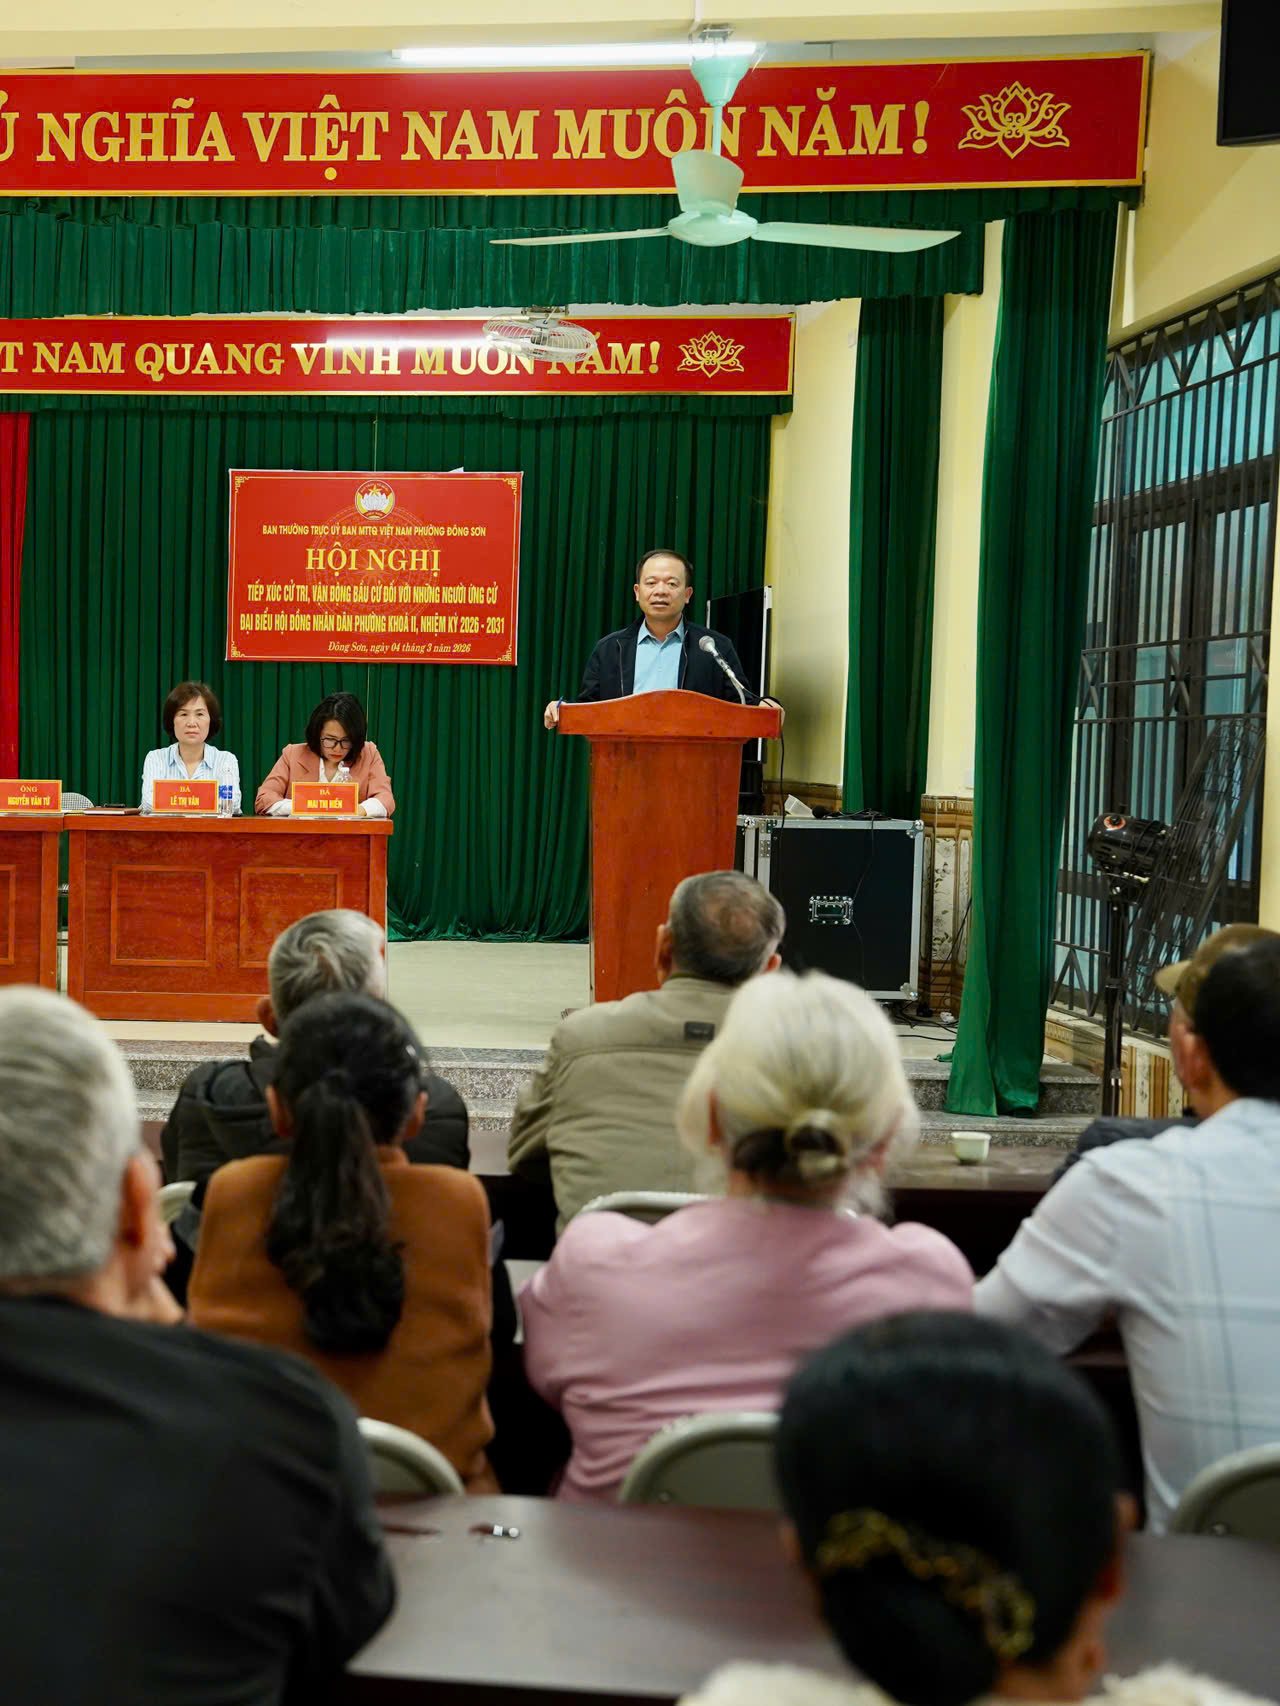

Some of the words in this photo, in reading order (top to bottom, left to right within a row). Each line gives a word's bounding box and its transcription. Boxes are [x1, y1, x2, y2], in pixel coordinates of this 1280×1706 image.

[35, 97, 235, 163] NGHĨA
[243, 94, 389, 181] VIỆT
[400, 109, 540, 160] NAM
[552, 89, 741, 160] MUÔN
[32, 341, 125, 374] NAM
[134, 341, 285, 382] QUANG
[291, 342, 401, 375] VINH
[262, 525, 278, 534] BAN
[279, 522, 309, 534] THƯỜNG
[311, 525, 329, 537] TRỰC
[342, 526, 356, 536] BAN
[358, 526, 378, 536] MTTQ
[380, 524, 394, 538] VIỆT
[396, 526, 412, 536] NAM
[414, 524, 444, 536] PHƯỜNG
[446, 524, 469, 536] ĐÔNG
[470, 525, 486, 536] SƠN
[305, 542, 359, 576] HỘI
[366, 548, 441, 578] NGHỊ
[248, 579, 264, 602] TIẾP
[266, 581, 282, 602] XÚC
[284, 579, 296, 602] CỬ
[296, 585, 310, 604] TRI,
[312, 582, 328, 606] VẬN
[330, 582, 351, 606] ĐỘNG
[353, 580, 368, 602] BẦU
[371, 580, 383, 603] CỬ
[384, 580, 396, 603] ĐỐI
[398, 582, 411, 603] VỚI
[413, 583, 440, 604] NHỮNG
[442, 582, 466, 604] NGƯỜI
[468, 582, 484, 604] ỨNG
[486, 581, 498, 604] CỬ
[240, 613, 254, 635] ĐẠI
[255, 606, 272, 631] BIỂU
[275, 610, 288, 635] HỘI
[290, 608, 311, 632] ĐỒNG
[312, 611, 334, 632] NHÂN
[336, 611, 352, 632] DÂN
[354, 611, 386, 632] PHƯỜNG
[410, 616, 418, 634] II,
[420, 612, 446, 636] NHIỆM
[448, 612, 458, 632] KỲ
[460, 617, 480, 634] 2026
[486, 617, 504, 634] 2031
[328, 641, 350, 654] Đông
[351, 642, 368, 653] Sơn,
[370, 642, 390, 654] ngày
[391, 642, 400, 652] 04
[402, 642, 426, 654] tháng
[426, 643, 432, 652] 3
[433, 644, 451, 653] năm
[452, 643, 472, 654] 2026
